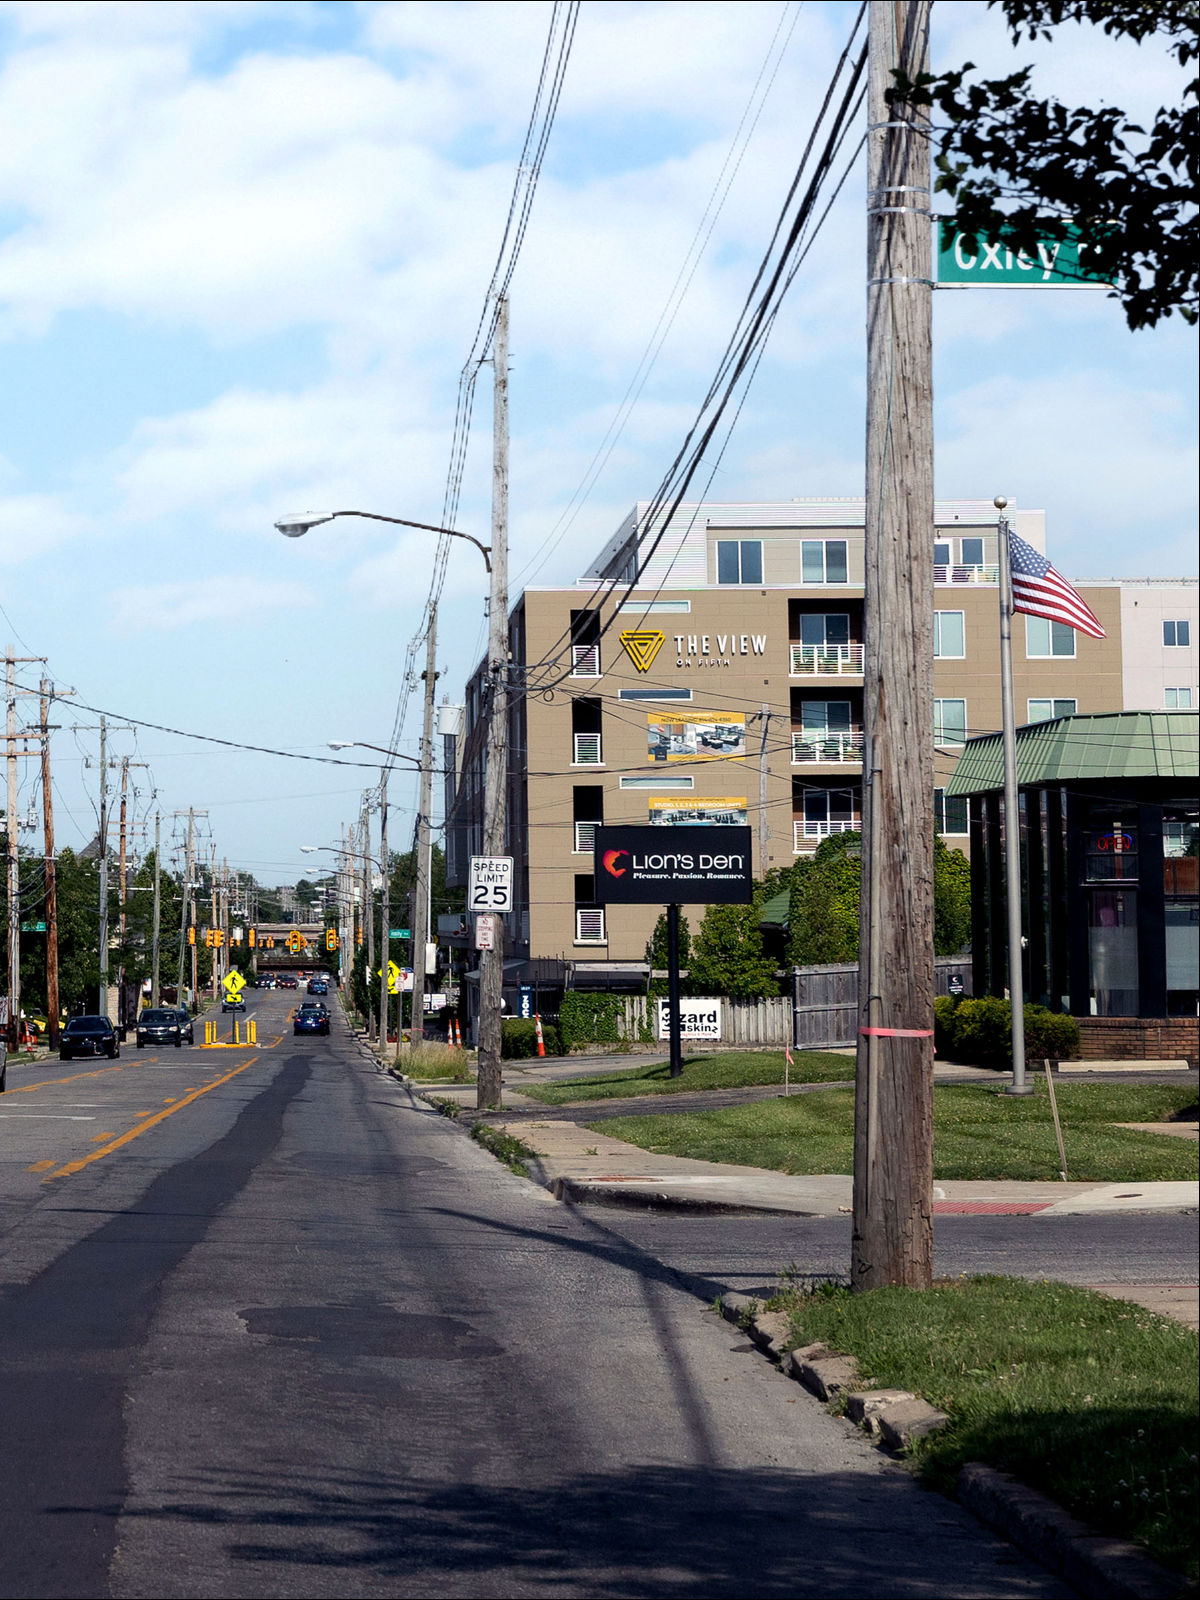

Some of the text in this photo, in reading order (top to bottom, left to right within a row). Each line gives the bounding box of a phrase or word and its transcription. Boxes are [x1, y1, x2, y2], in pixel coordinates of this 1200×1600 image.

[674, 635, 766, 654] THE VIEW
[677, 659, 730, 667] ON FIFTH
[1097, 837, 1130, 850] OPEN
[474, 863, 509, 872] SPEED
[477, 874, 504, 882] LIMIT
[474, 885, 507, 905] 25
[679, 1010, 717, 1023] zard
